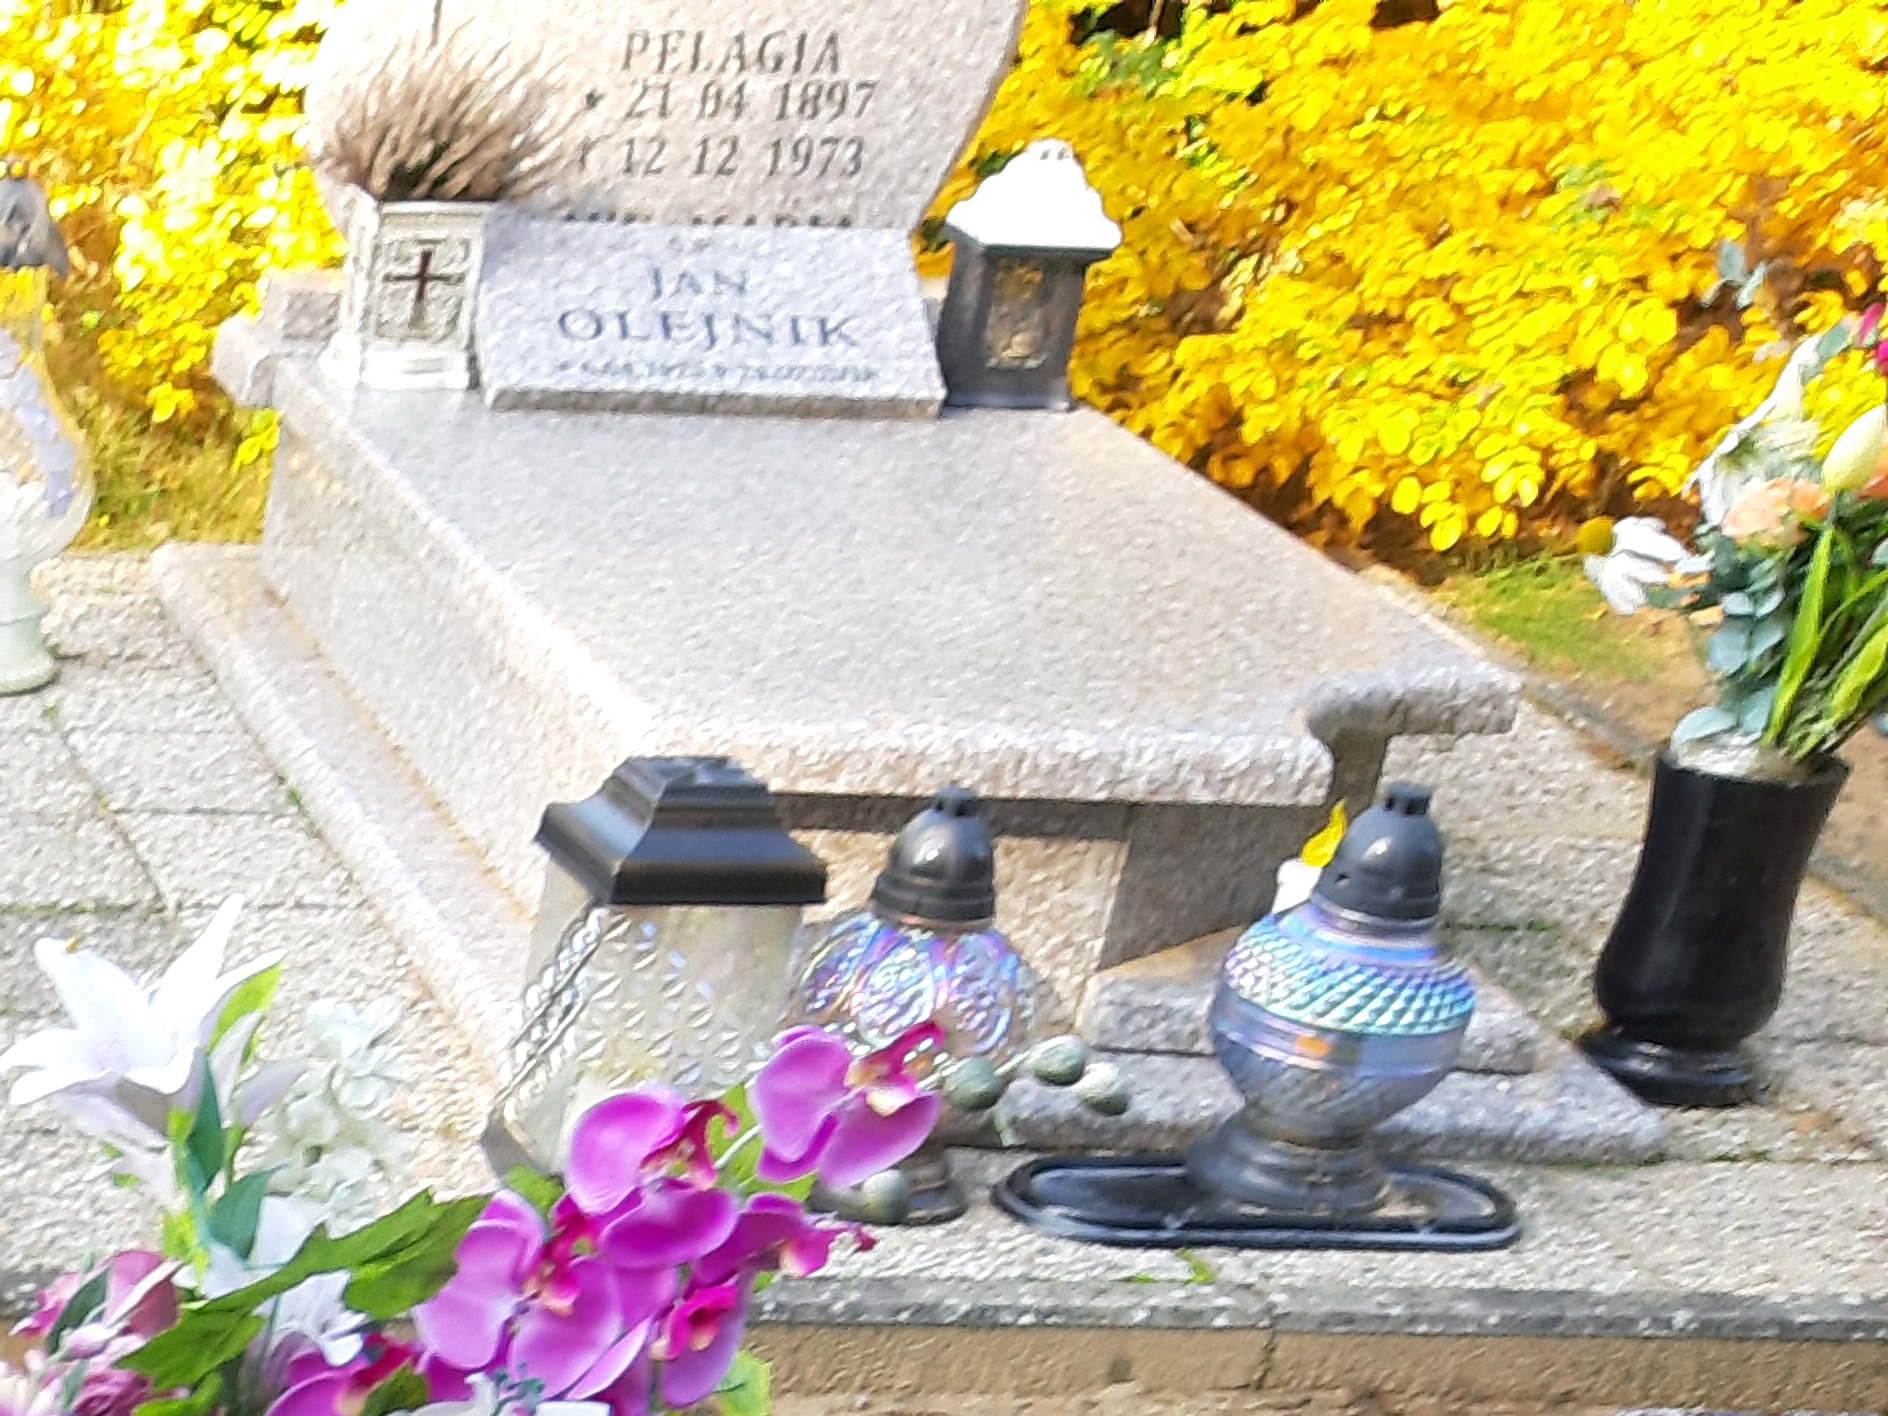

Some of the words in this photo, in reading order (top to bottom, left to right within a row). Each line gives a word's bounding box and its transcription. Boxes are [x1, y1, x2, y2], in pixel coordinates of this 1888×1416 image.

[619, 28, 844, 75] PELAGIA
[775, 79, 880, 123] 1897
[621, 134, 670, 176] 12
[693, 134, 742, 178] 12
[768, 133, 866, 180] 1973
[647, 263, 751, 301] JAN
[557, 307, 860, 352] OLEJNIK
